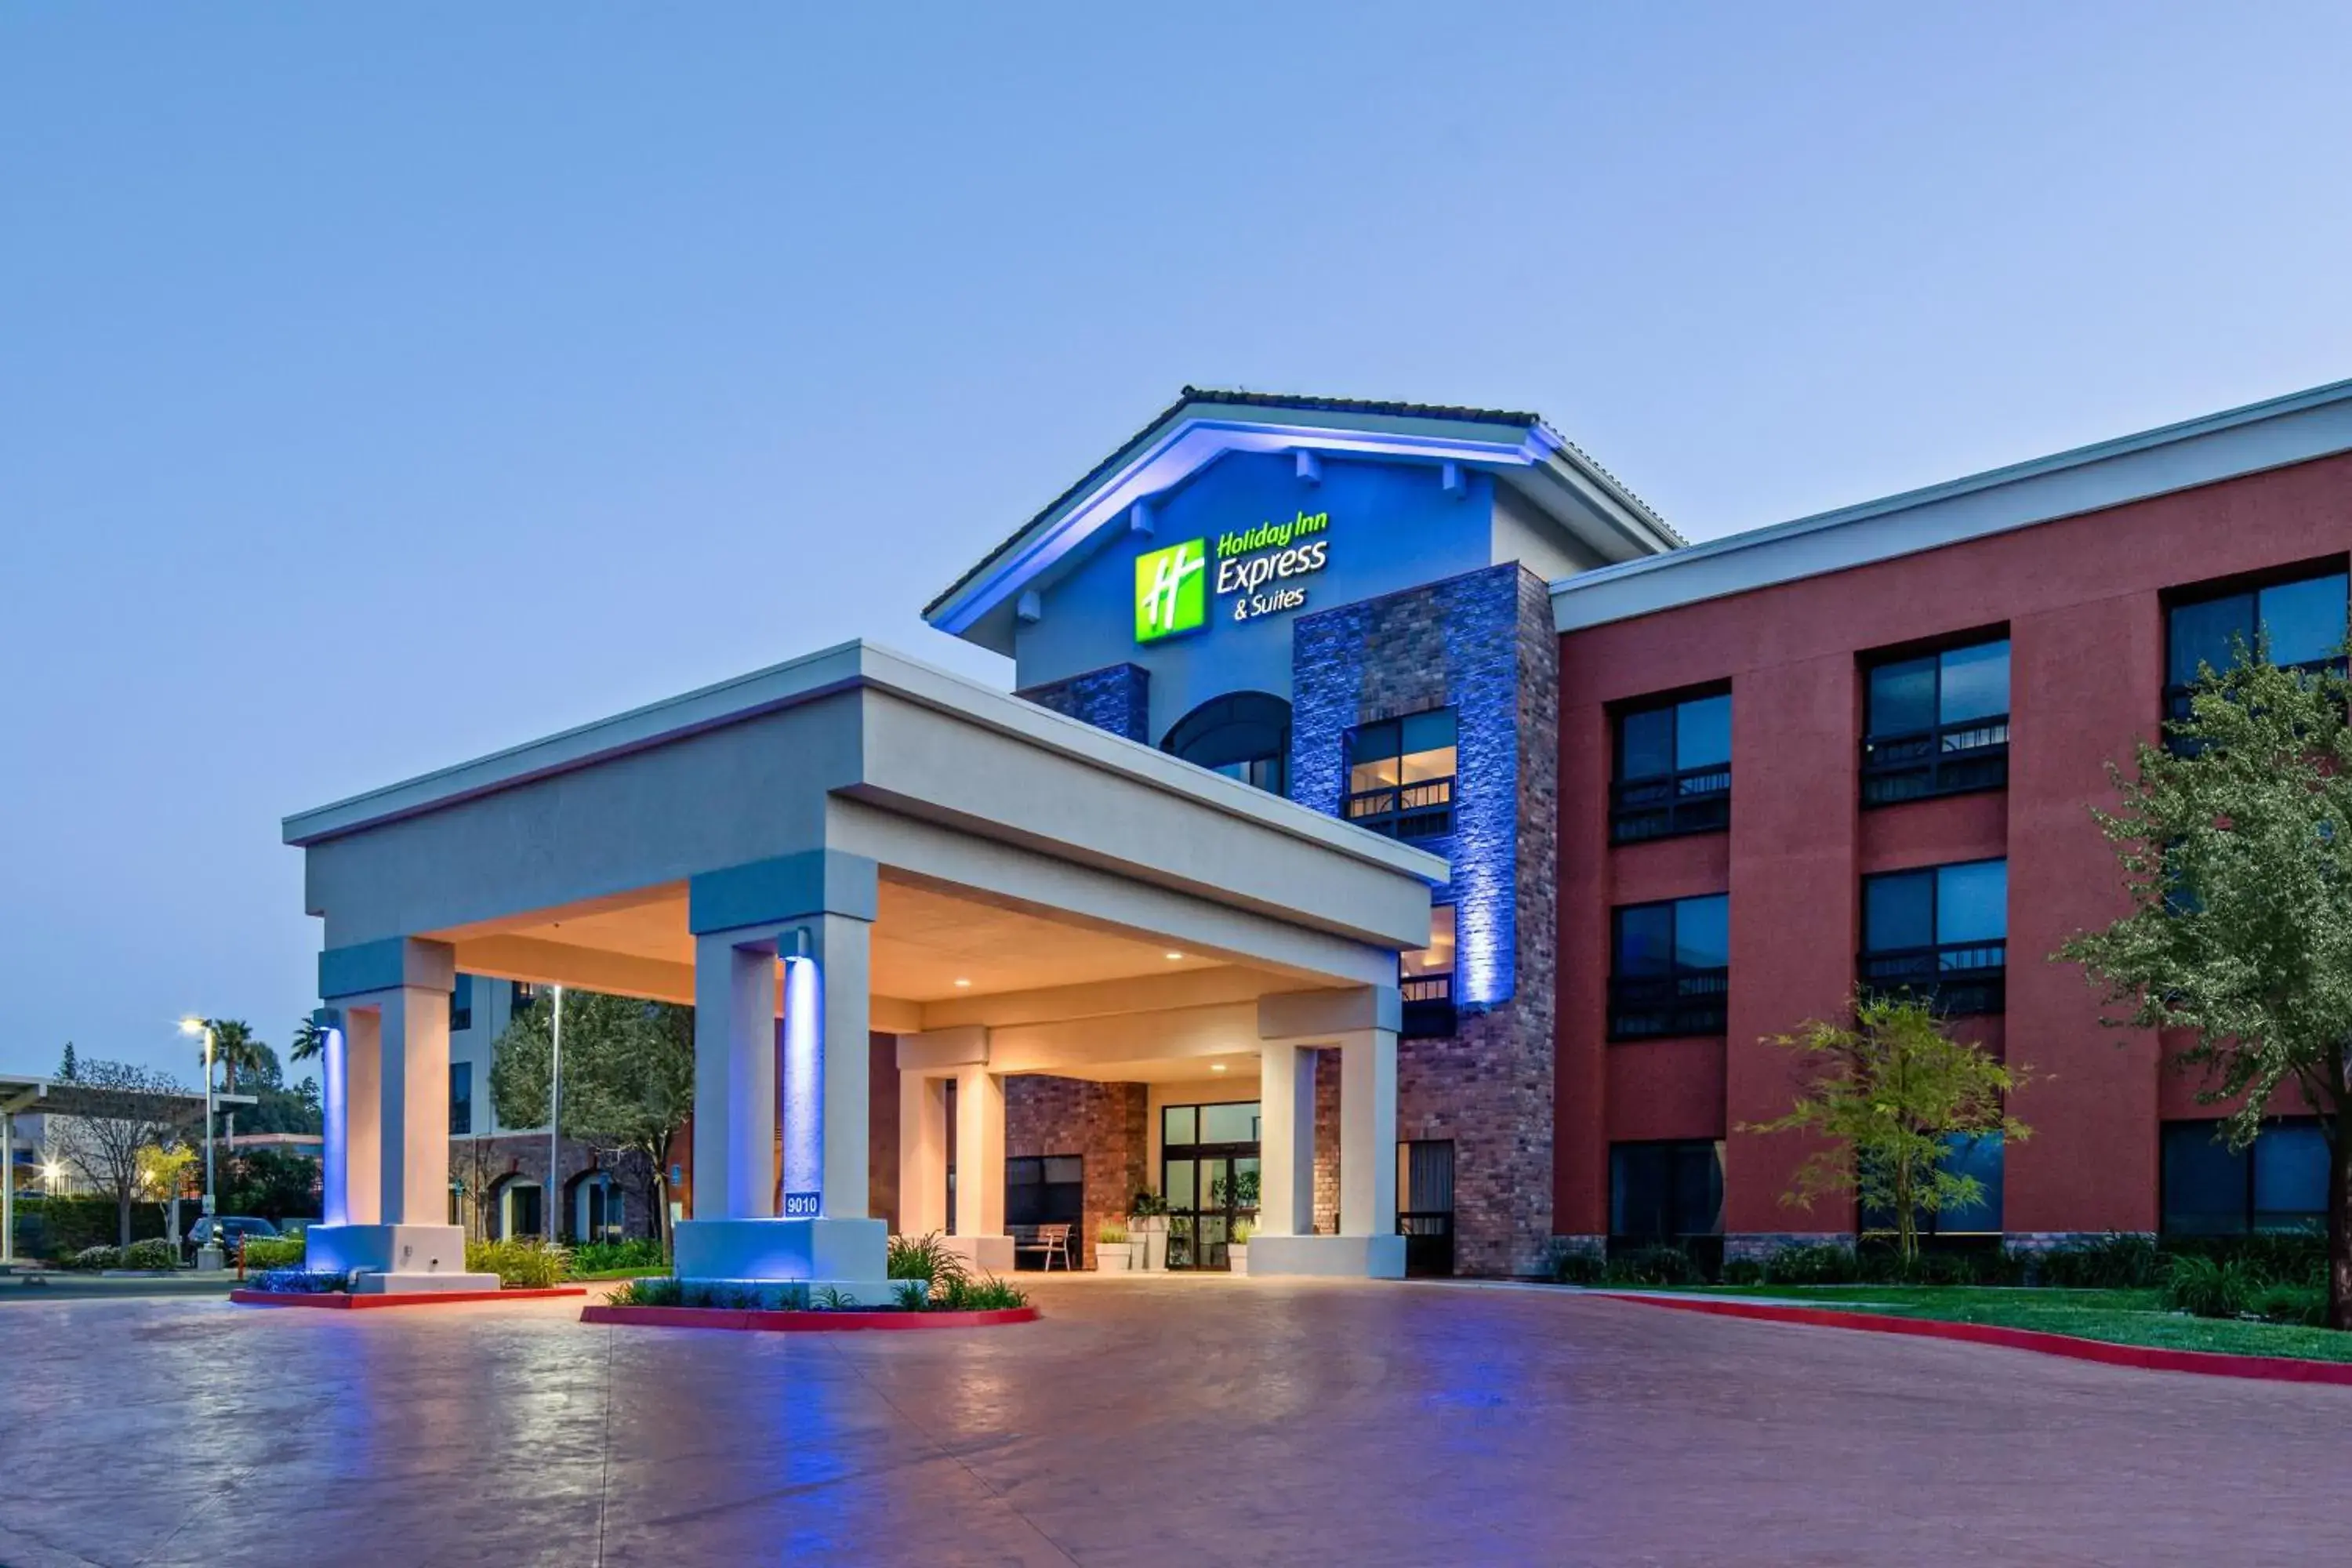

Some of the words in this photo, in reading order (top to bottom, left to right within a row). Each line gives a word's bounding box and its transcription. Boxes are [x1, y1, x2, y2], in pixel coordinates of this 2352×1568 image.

[1217, 521, 1293, 558] Holiday
[1295, 510, 1328, 536] Inn
[1142, 545, 1205, 630] H
[1217, 541, 1328, 594] Express
[1234, 598, 1247, 621] &
[1251, 588, 1305, 616] Suites
[788, 1196, 817, 1213] 9010
